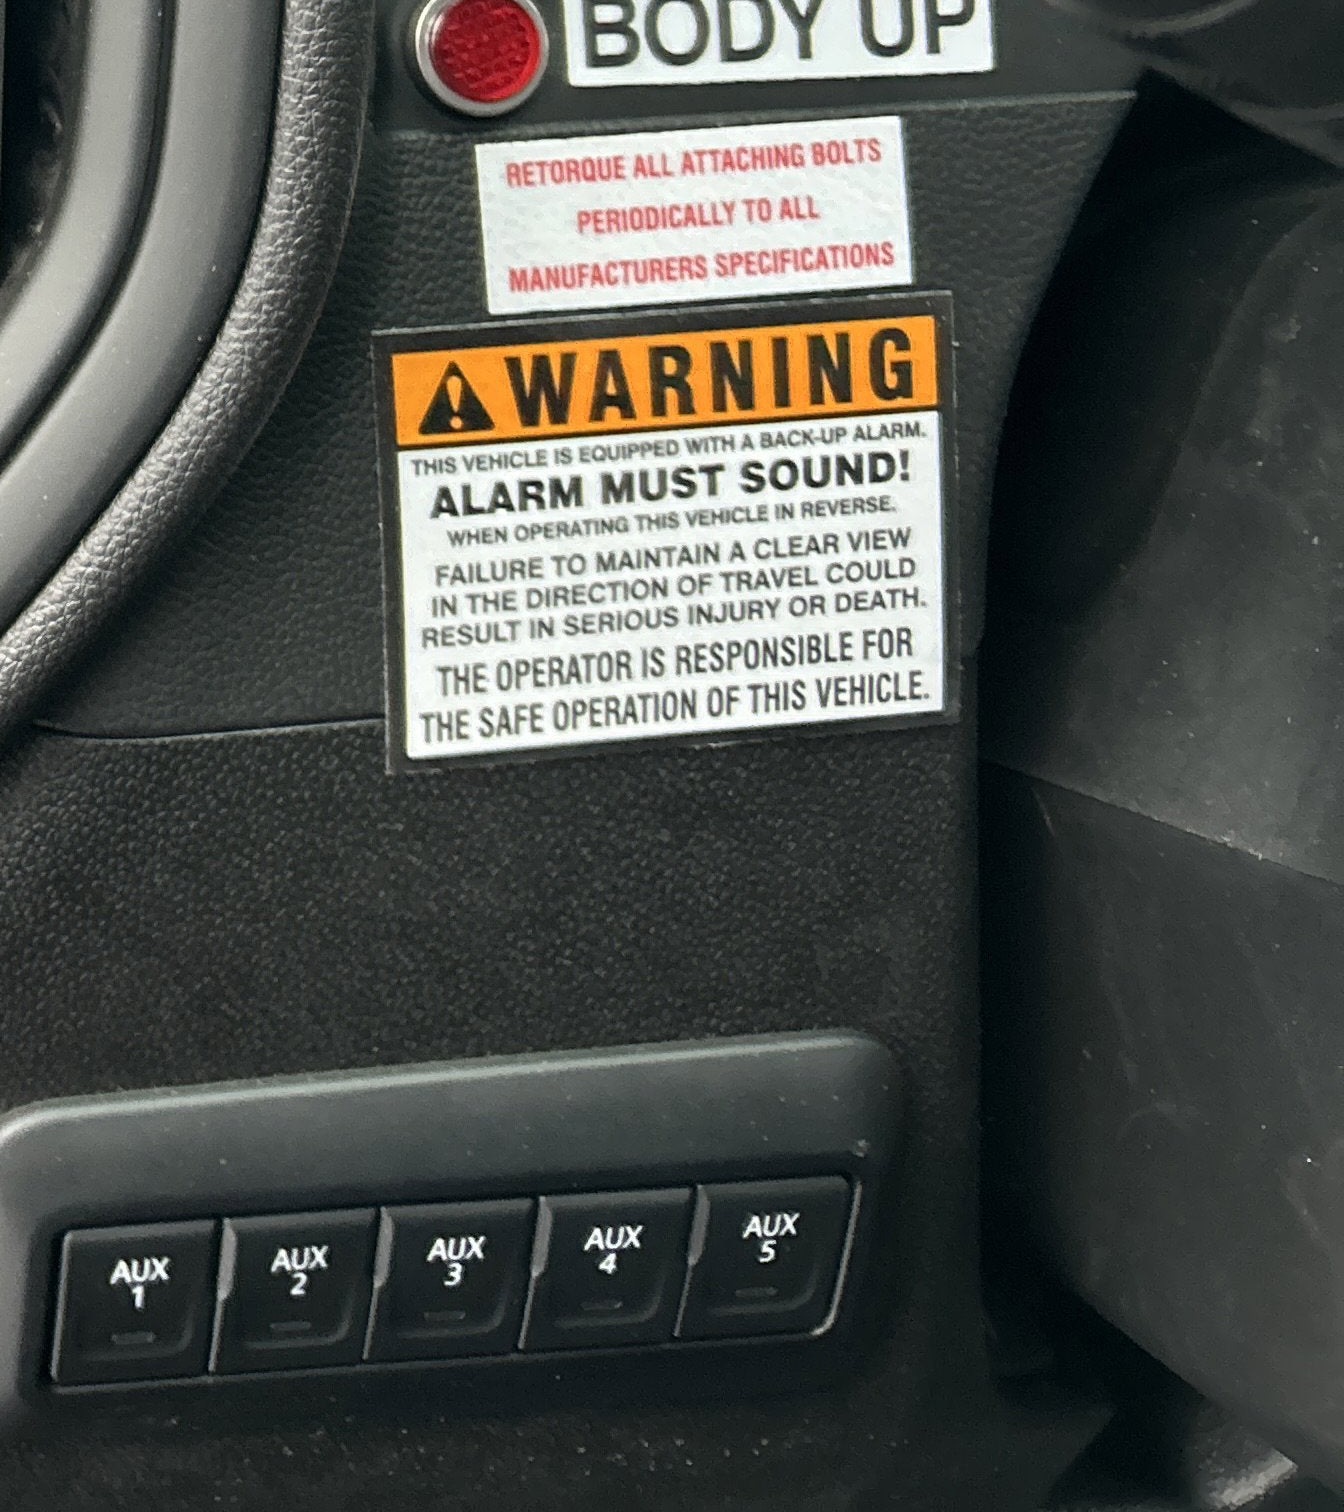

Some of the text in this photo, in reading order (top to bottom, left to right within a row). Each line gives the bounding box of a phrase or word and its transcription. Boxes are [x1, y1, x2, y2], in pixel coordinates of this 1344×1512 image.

[505, 137, 883, 189] RETORQUE ALL ATTACHING BOLTS
[576, 194, 822, 236] PERIODICALLY TO ALL
[507, 240, 895, 293] MANUFACTURERS SPECIFICATIONS
[503, 326, 914, 428] WARNING
[410, 420, 927, 477] THIS VEHICLE IS EQUIPPED WITH A BACK-UP ALARM.
[429, 448, 910, 520] ALARM MUST SOUND!
[446, 494, 897, 548] WHEN OPERATING THIS VEHICLE IN REVERSE.
[434, 526, 912, 587] FAILURE TO MAINTAIN A CLEAR VIEW
[431, 556, 917, 618] IN THE DIRECTION OF TRAVEL COULD
[421, 586, 927, 649] RESULT IN SERIOUS INJURY OR DEATH.
[435, 626, 914, 697] THE OPERATOR IS RESPONSIBLE FOR
[418, 669, 930, 744] THE SAFE OPERATION OF THIS VEHICLE.
[426, 1235, 486, 1262] AUX
[583, 1224, 644, 1252] AUX
[742, 1212, 800, 1239] AUX
[109, 1256, 170, 1285] AUX
[270, 1245, 329, 1273] AUX
[443, 1262, 463, 1286] 3
[598, 1252, 617, 1275] 4
[758, 1239, 777, 1264] 5
[130, 1285, 145, 1309] 1
[290, 1273, 308, 1296] 2
